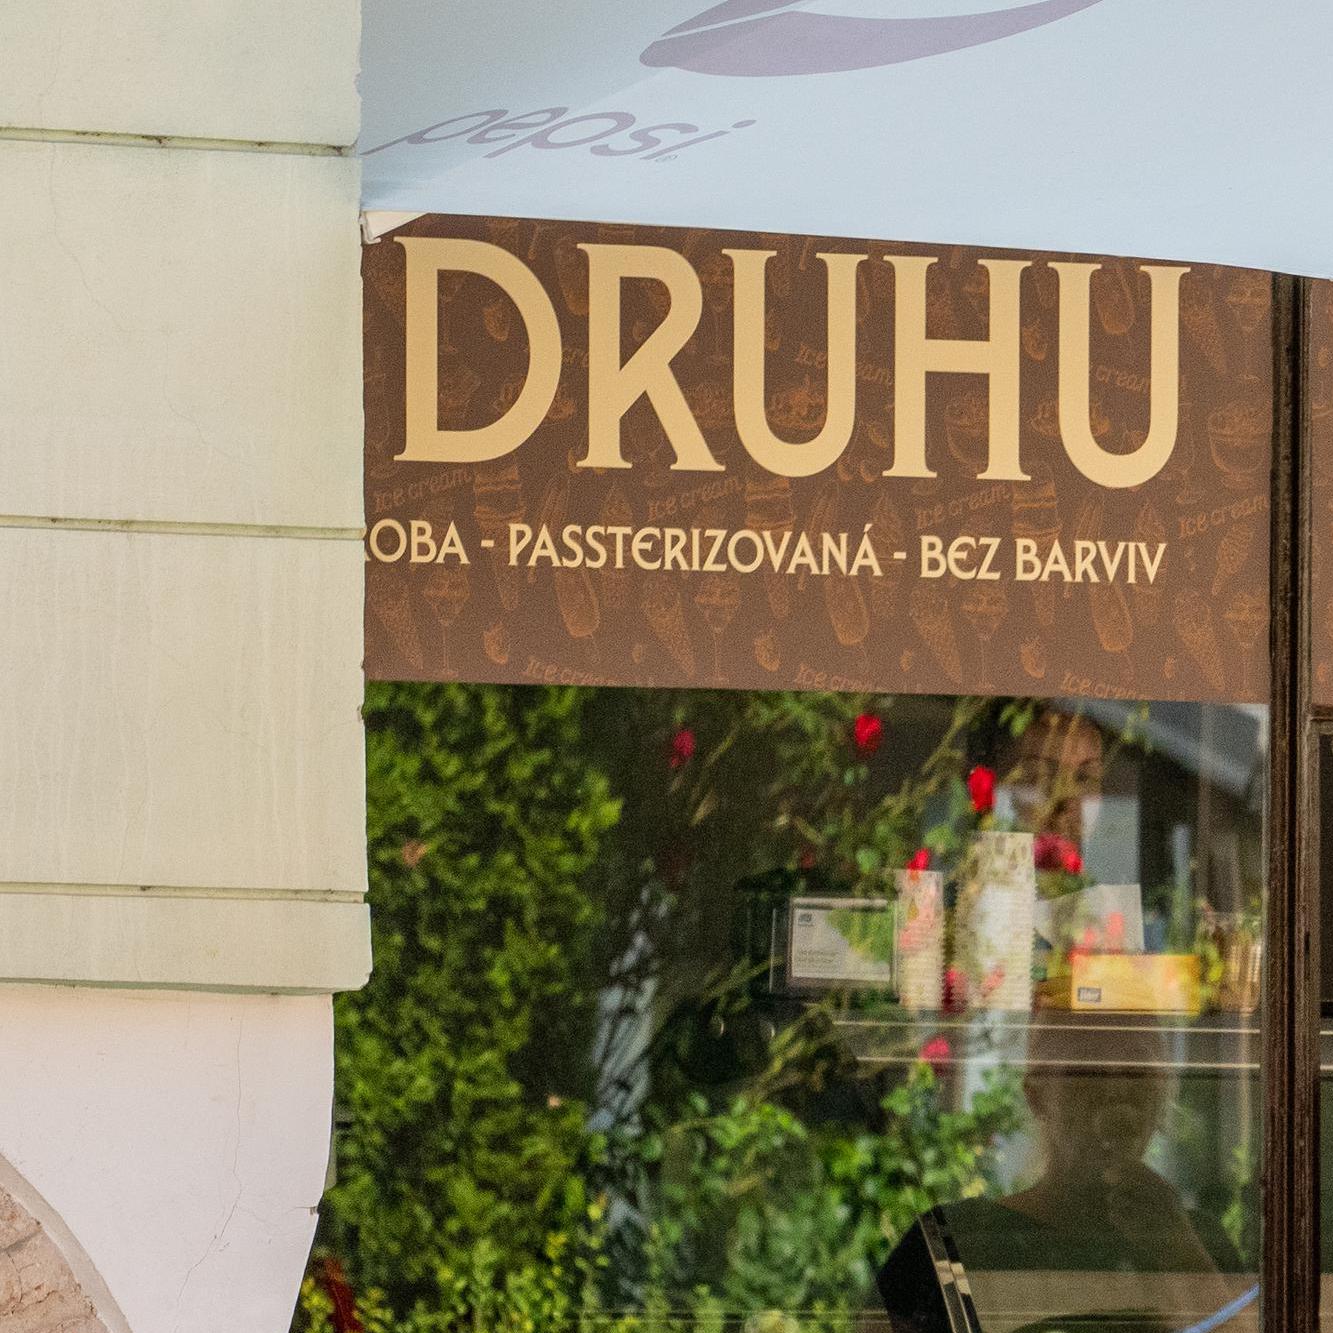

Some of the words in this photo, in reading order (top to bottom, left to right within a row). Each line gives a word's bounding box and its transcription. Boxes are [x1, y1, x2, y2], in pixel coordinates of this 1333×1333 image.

[360, 105, 756, 163] pepsi
[393, 236, 1191, 488] DRUHU
[365, 518, 470, 565] OBA
[507, 521, 884, 577] PASSTERIZOVANÁ
[920, 533, 1003, 581] BEZ
[1014, 536, 1168, 585] BARVIV
